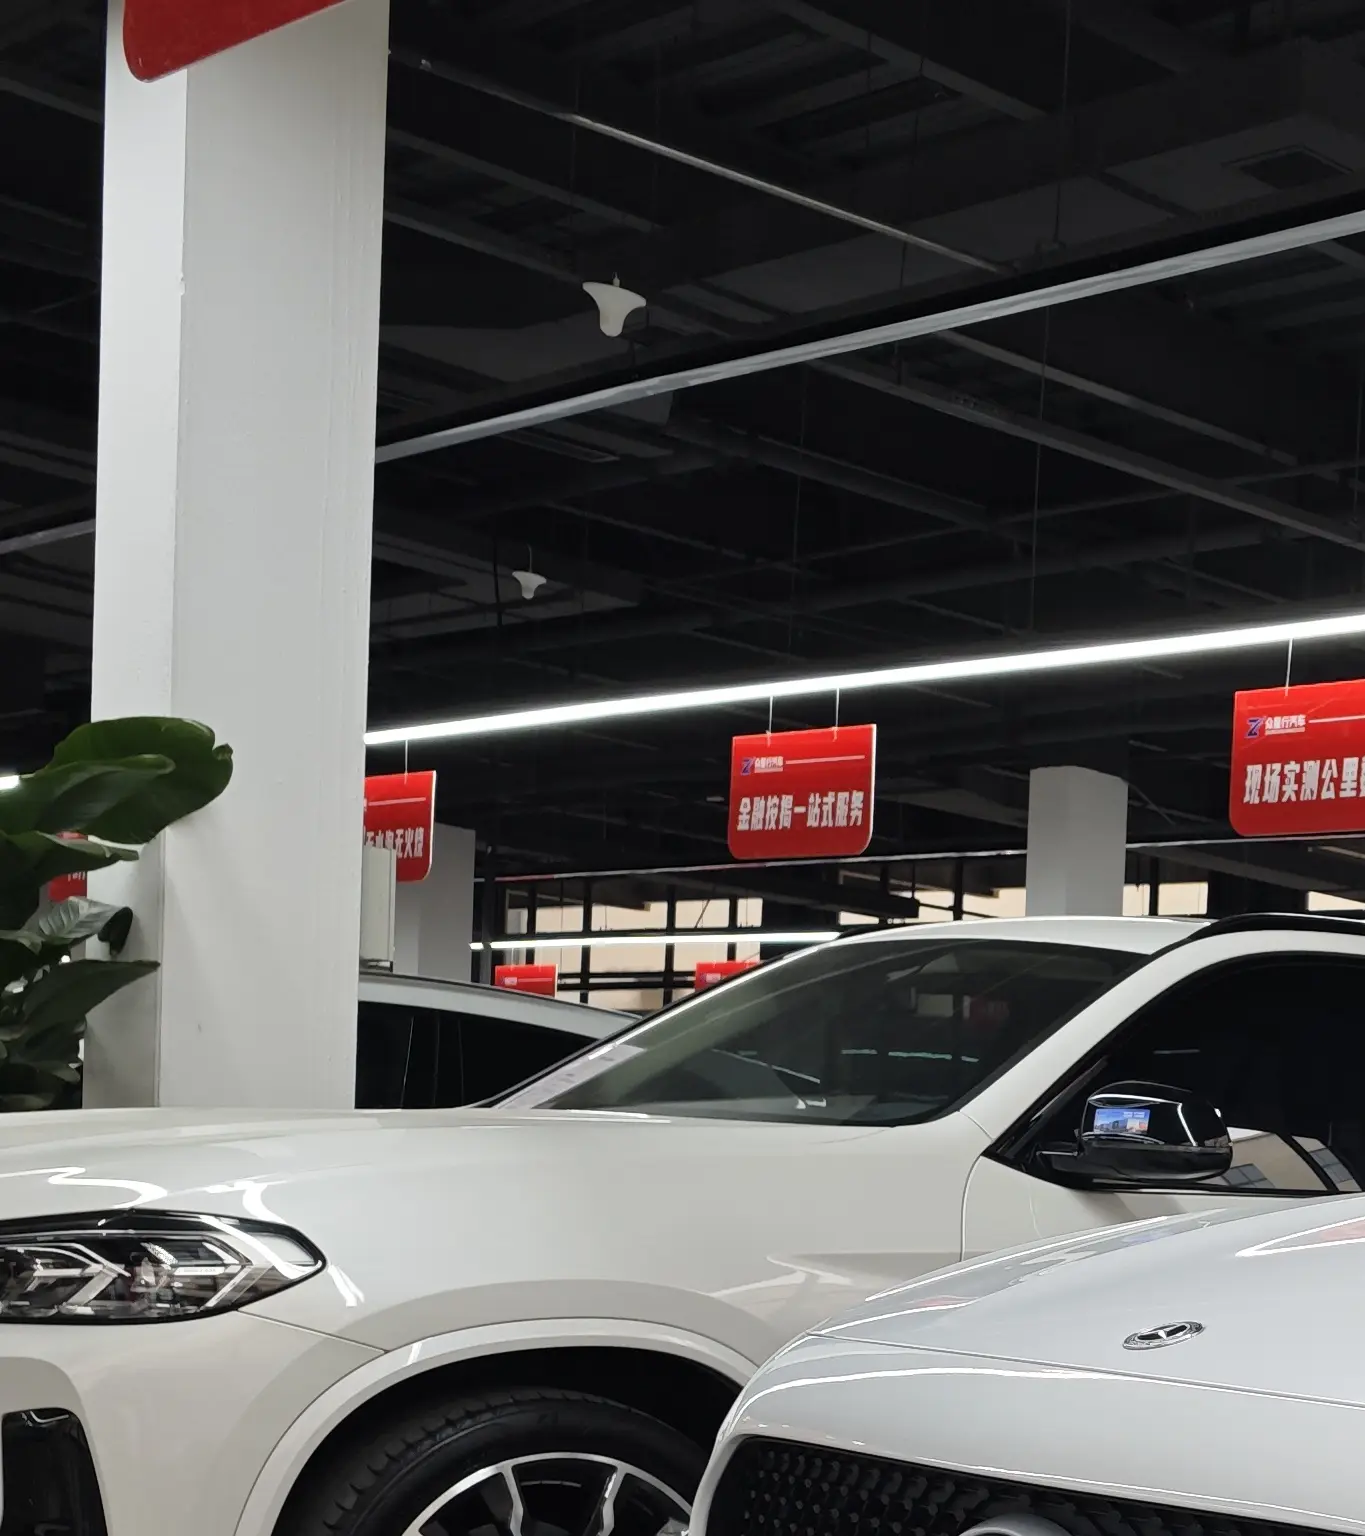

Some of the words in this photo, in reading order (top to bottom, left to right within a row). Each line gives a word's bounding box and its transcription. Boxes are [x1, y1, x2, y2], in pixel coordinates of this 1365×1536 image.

[737, 790, 864, 831] 金融按揭一站式服务
